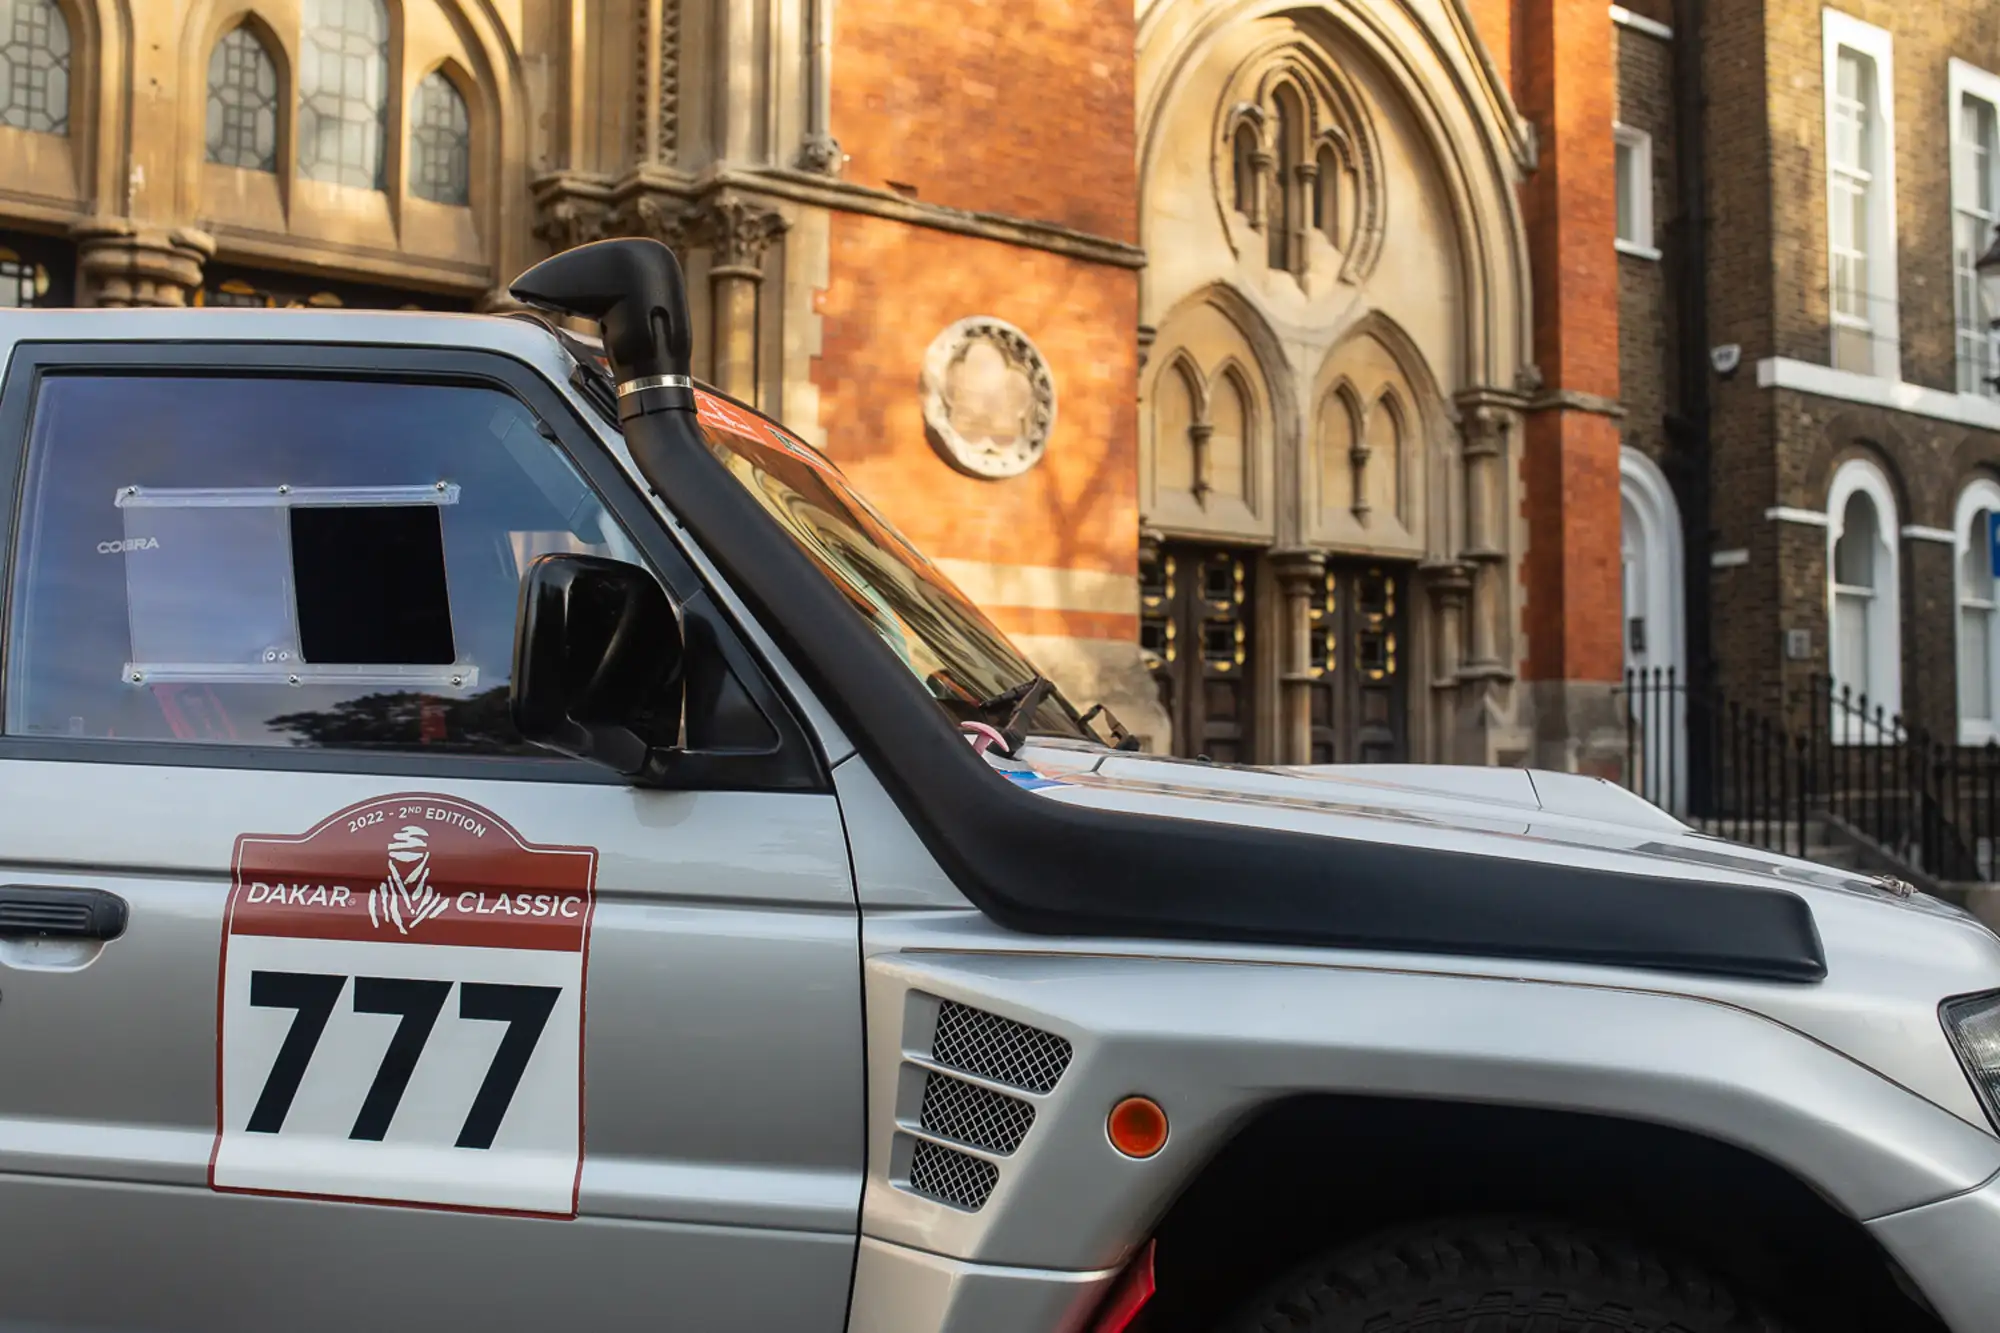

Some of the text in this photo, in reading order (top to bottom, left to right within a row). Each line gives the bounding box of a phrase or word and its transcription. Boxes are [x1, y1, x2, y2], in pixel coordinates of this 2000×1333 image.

[96, 536, 160, 554] COBRA
[347, 811, 385, 833] 2022
[398, 806, 423, 819] 2ND
[425, 807, 487, 838] EDITION
[456, 890, 581, 918] CLASSIC
[245, 970, 563, 1150] 777
